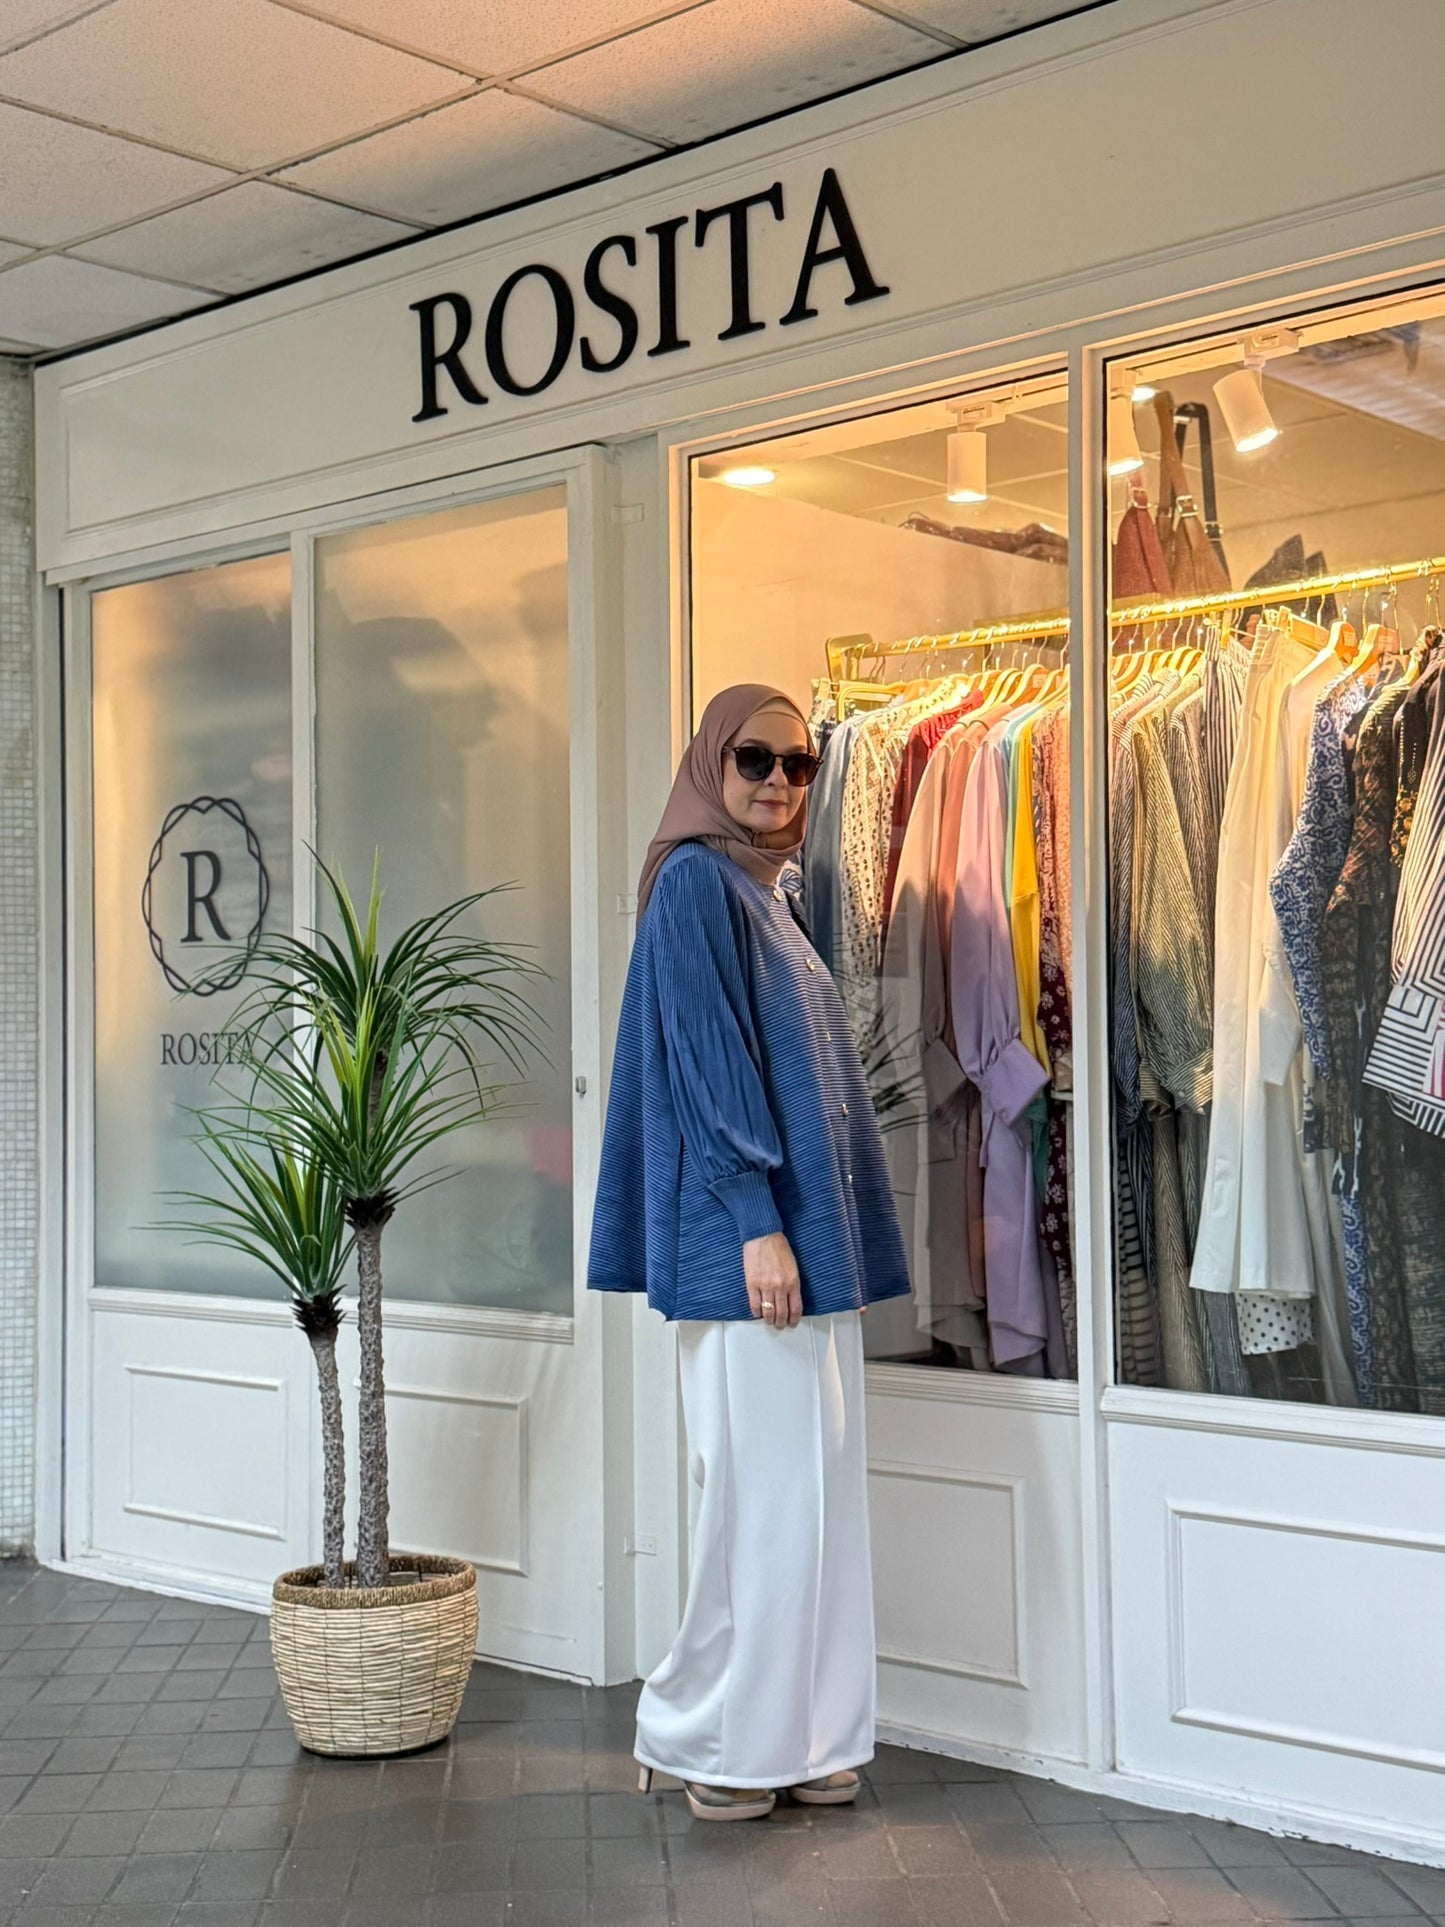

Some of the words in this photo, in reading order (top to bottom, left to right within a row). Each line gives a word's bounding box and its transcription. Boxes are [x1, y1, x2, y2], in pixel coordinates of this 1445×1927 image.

[409, 168, 889, 421] ROSITA
[180, 850, 231, 942] R
[160, 1032, 254, 1065] ROSITA
